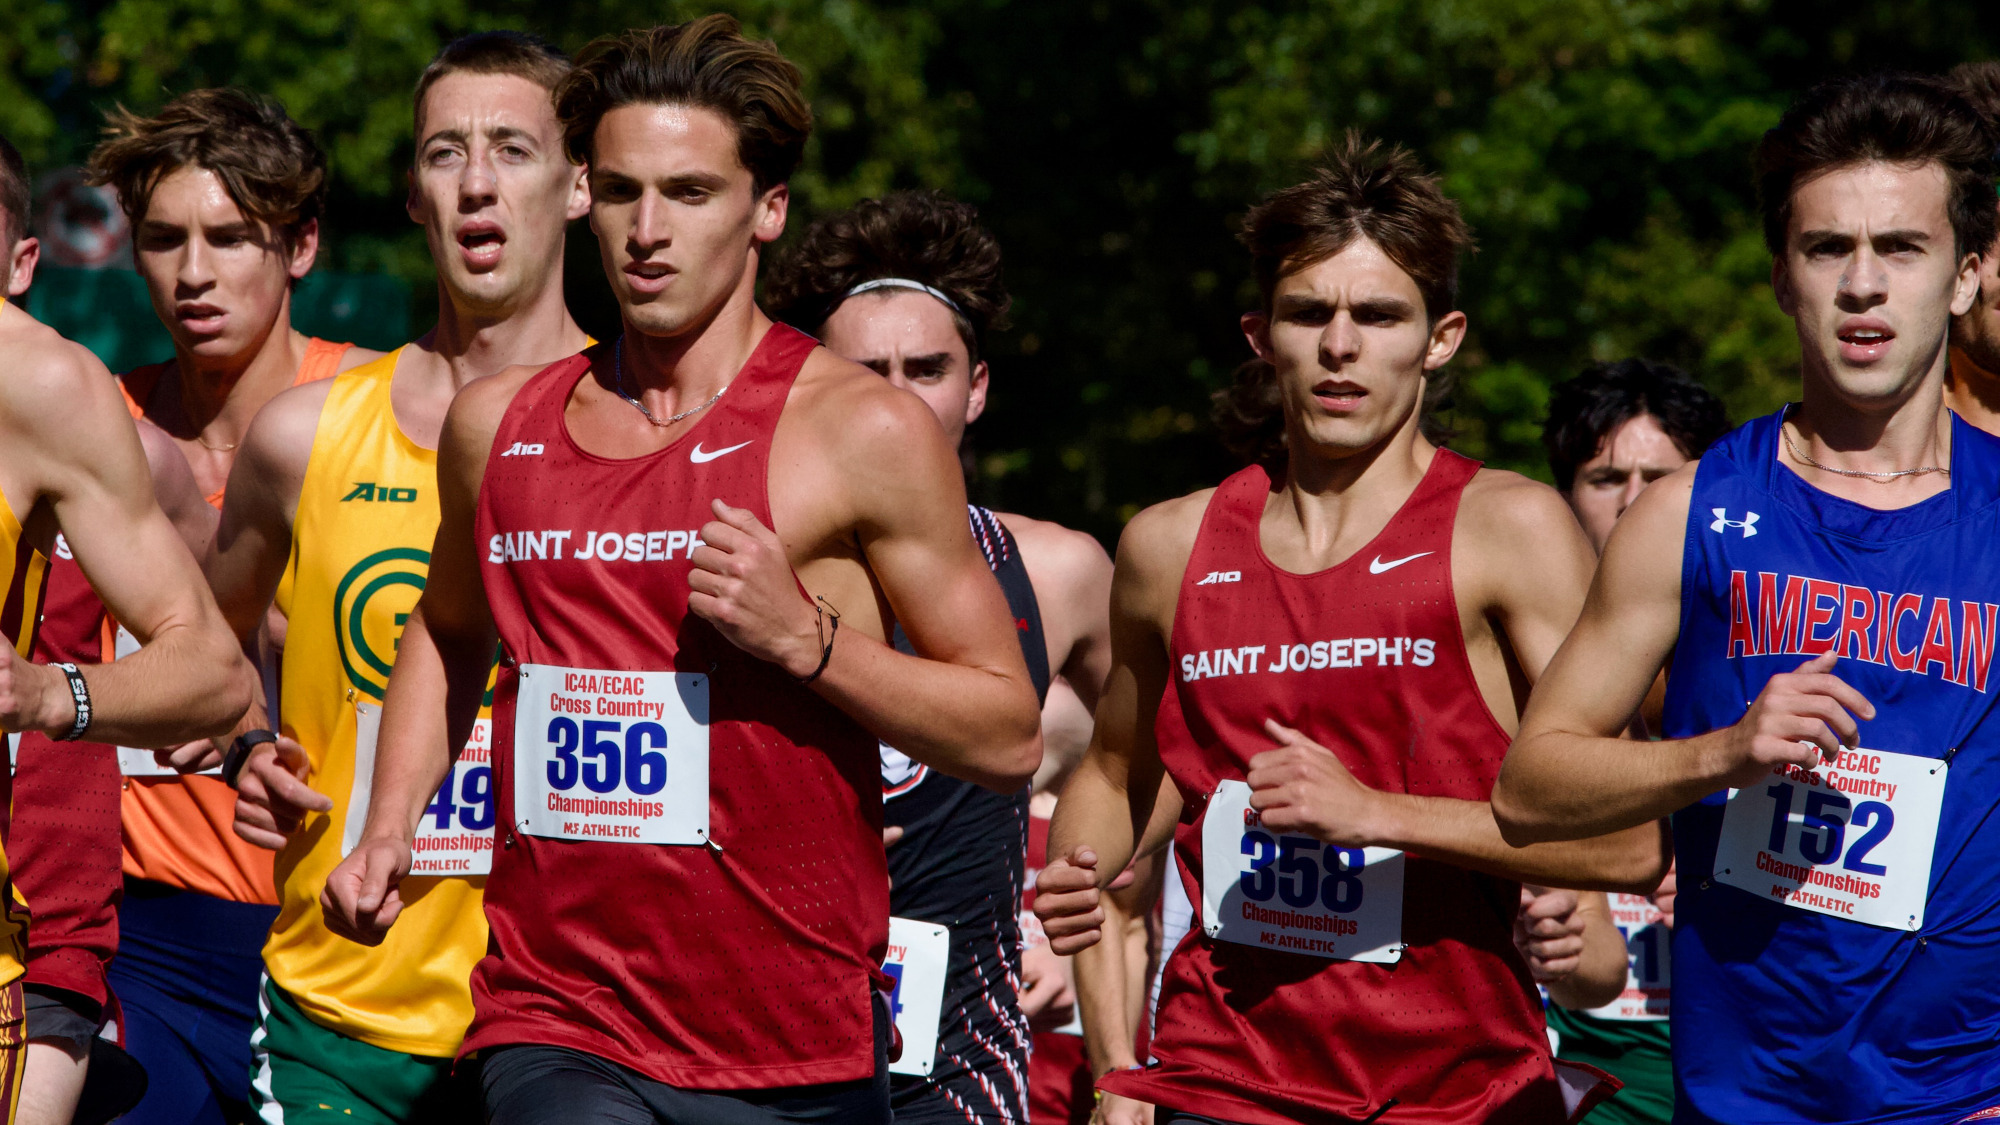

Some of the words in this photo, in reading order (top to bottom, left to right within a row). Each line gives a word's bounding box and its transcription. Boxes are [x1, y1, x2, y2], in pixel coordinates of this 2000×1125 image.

[500, 442, 545, 457] A10
[340, 482, 418, 502] A10
[488, 529, 572, 564] SAINT
[1196, 570, 1242, 585] A10
[1726, 570, 2000, 694] AMERICAN
[1181, 644, 1266, 683] SAINT
[1268, 637, 1436, 672] JOSEPH'S
[565, 673, 644, 696] IC4A/ECAC
[550, 693, 591, 714] Cross
[597, 697, 664, 720] Country
[547, 717, 667, 795] 356
[424, 766, 495, 831] 49
[1826, 771, 1897, 801] Country
[548, 792, 664, 820] Championships
[582, 823, 640, 838] ATHLETIC
[1767, 782, 1895, 877] 152
[412, 859, 470, 870] ATHLETIC
[1240, 831, 1365, 913] 358
[1756, 851, 1882, 899] Championships
[1791, 890, 1855, 915] ATHLETIC
[1242, 902, 1357, 936] Championships
[1278, 935, 1335, 953] ATHLETIC
